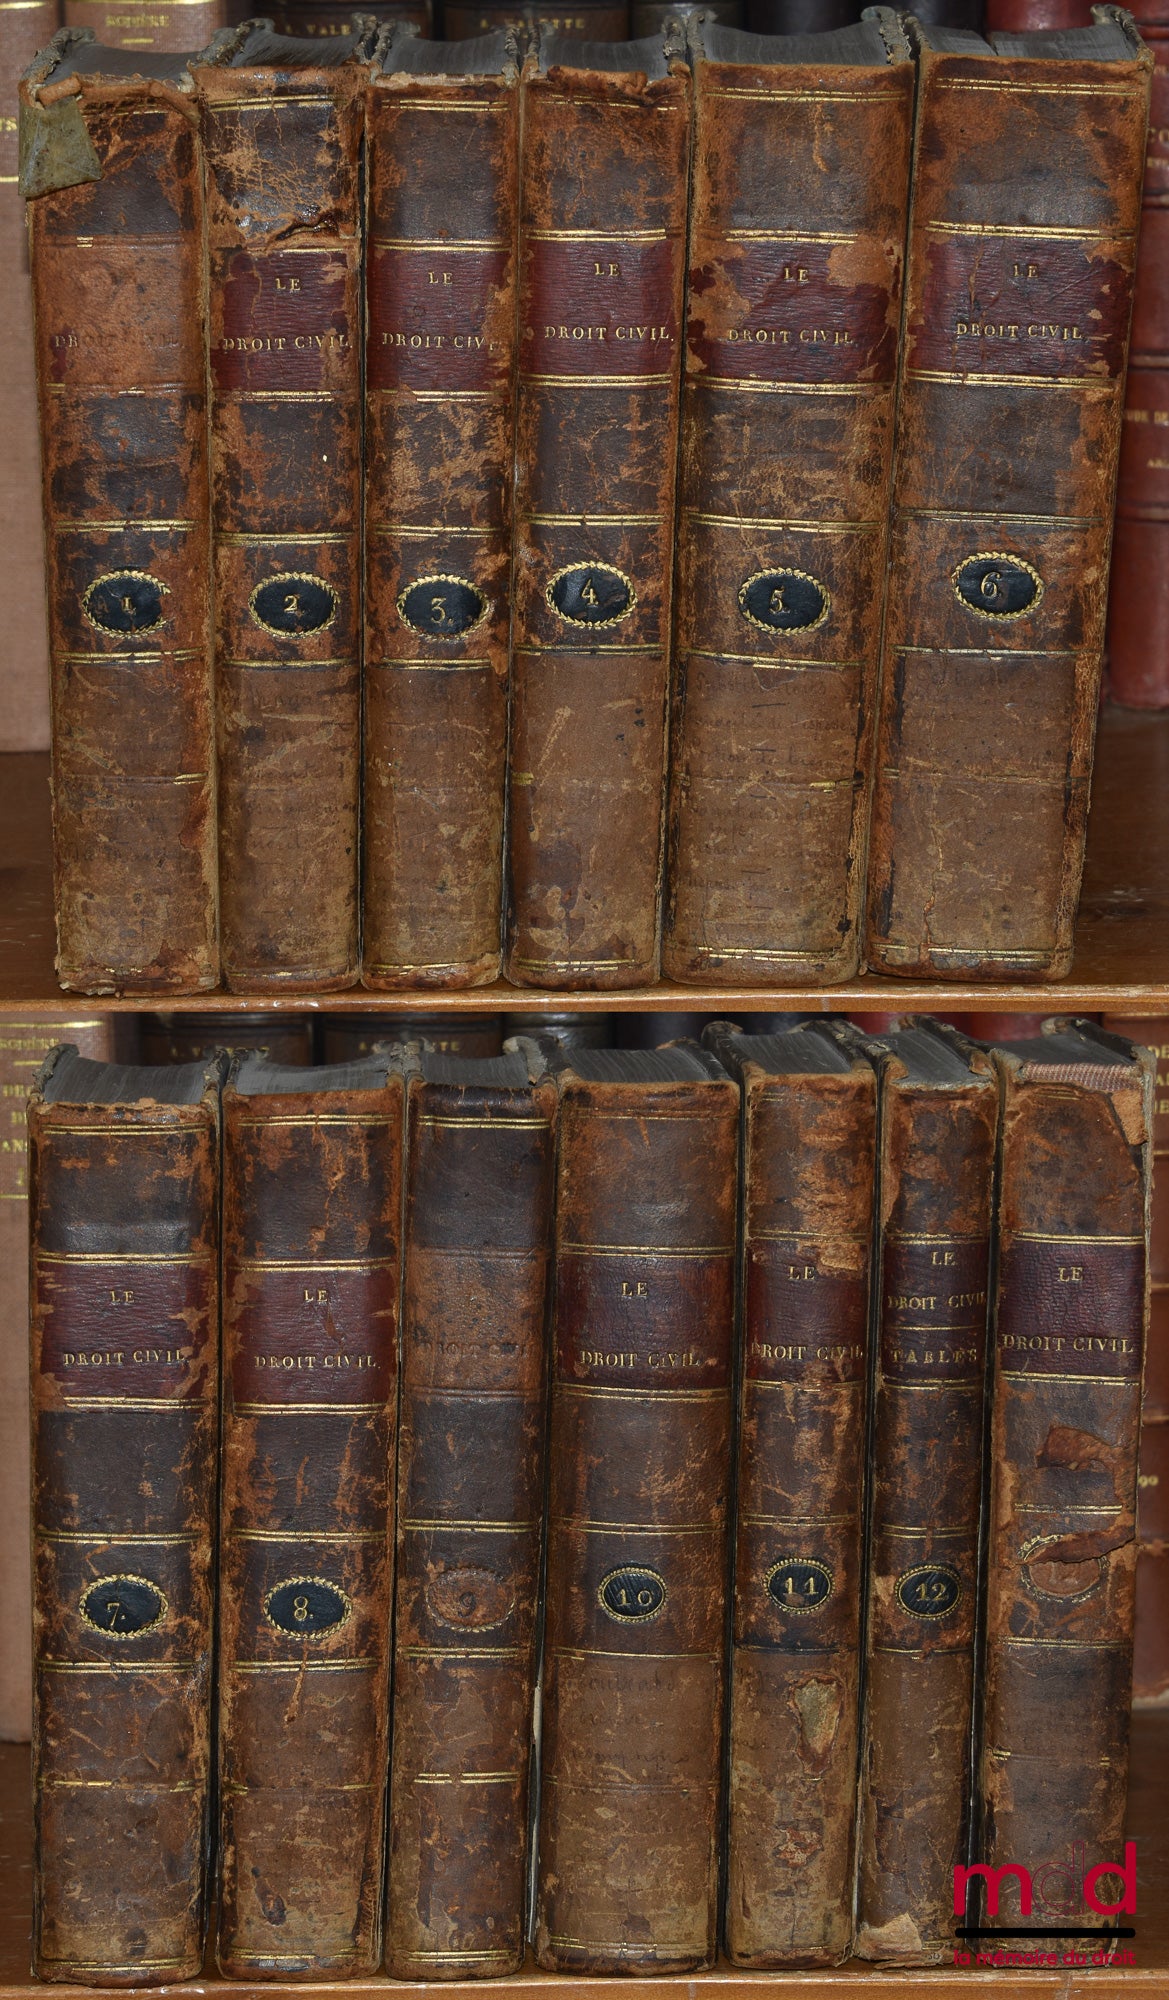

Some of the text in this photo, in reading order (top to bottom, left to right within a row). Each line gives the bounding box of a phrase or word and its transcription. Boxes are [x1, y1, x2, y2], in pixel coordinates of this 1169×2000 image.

[593, 263, 620, 277] LE
[783, 267, 809, 282] LE
[1012, 264, 1039, 278] LE
[275, 278, 301, 291] LE
[428, 271, 453, 285] LE
[544, 326, 675, 342] DROIT CIVIL.
[728, 329, 791, 343] DROIT
[956, 323, 1019, 338] DROIT
[223, 336, 286, 351] DROIT
[382, 332, 446, 349] DROIT
[581, 579, 599, 608] 4
[931, 1251, 957, 1266] LE
[787, 1265, 816, 1280] LE
[1056, 1266, 1084, 1282] LE
[109, 1290, 135, 1304] LE
[303, 1289, 328, 1303] LE
[620, 1282, 649, 1297] LE
[887, 1295, 937, 1310] DROIT
[1001, 1333, 1134, 1353] DROIT CIVIL
[63, 1351, 125, 1366] DROIT
[580, 1350, 637, 1367] DROIT
[751, 1342, 807, 1360] DROIT
[890, 1348, 977, 1364] TABLES
[254, 1355, 316, 1369] DROIT
[783, 1576, 820, 1596] 11
[915, 1581, 948, 1603] 12
[615, 1588, 653, 1608] 10
